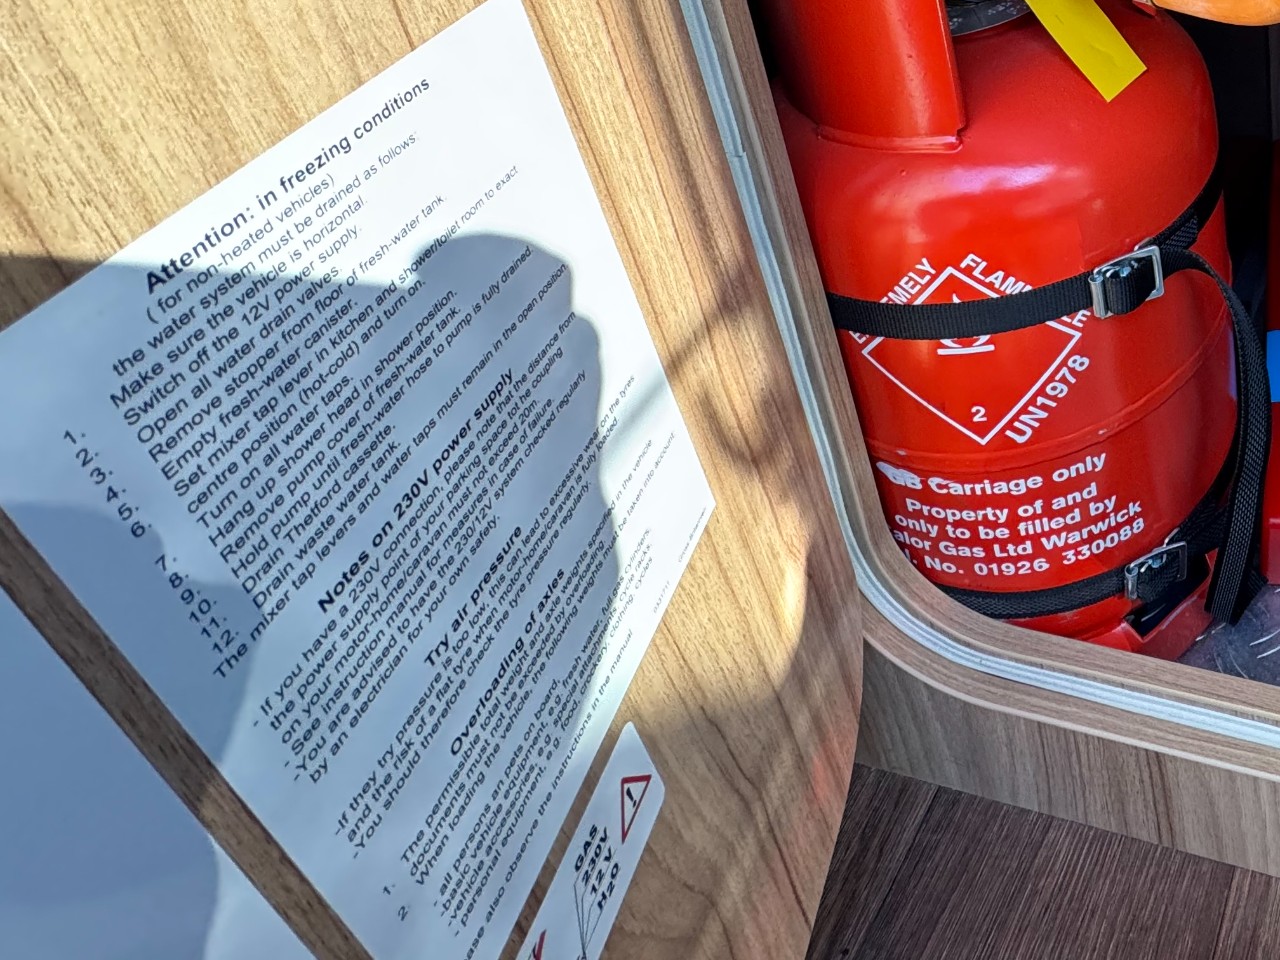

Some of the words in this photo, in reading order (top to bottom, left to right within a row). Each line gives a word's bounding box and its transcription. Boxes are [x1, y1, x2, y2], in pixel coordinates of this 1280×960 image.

[111, 347, 146, 377] the
[145, 304, 197, 350] water
[198, 260, 257, 310] system
[256, 227, 295, 265] must
[292, 214, 313, 235] be
[313, 173, 362, 218] drained
[361, 163, 378, 181] as
[145, 205, 255, 296] Attention:
[254, 189, 279, 211] in
[278, 135, 352, 194] freezing
[352, 77, 430, 140] conditions
[61, 428, 87, 446] 1.
[108, 361, 165, 411] Make
[165, 327, 206, 364] sure
[205, 303, 235, 331] the
[234, 260, 288, 306] vehicle
[286, 247, 303, 264] is
[74, 445, 100, 469] 2.
[121, 370, 187, 427] Switch
[187, 344, 211, 374] off
[210, 325, 240, 353] the
[239, 292, 270, 327] 12V
[272, 259, 316, 305] power
[88, 465, 115, 487] 3.
[135, 396, 190, 445] Open
[189, 372, 213, 400] all
[210, 335, 256, 380] water
[257, 303, 297, 341] drain
[294, 265, 343, 306] valves.
[848, 257, 937, 344] EMELY
[1004, 354, 1090, 444] UN1978
[116, 501, 141, 522] 5.
[158, 424, 218, 482] Empty
[217, 345, 302, 429] fresh-water
[302, 297, 359, 350] canister.
[152, 552, 178, 573] 7.
[194, 488, 239, 529] Turn
[238, 465, 262, 491] on
[261, 441, 282, 468] all
[279, 402, 320, 447] water
[319, 374, 355, 408] taps.
[167, 571, 190, 591] 8.
[206, 498, 256, 549] Hang
[253, 475, 277, 501] up
[276, 420, 326, 478] shower
[325, 383, 362, 425] head
[358, 373, 375, 391] in
[373, 329, 414, 380] shower
[413, 289, 458, 337] position.
[178, 586, 203, 606] 9.
[218, 493, 285, 565] Remove
[284, 449, 326, 498] pump
[325, 408, 361, 451] cover
[361, 390, 376, 413] of
[374, 328, 437, 399] fresh-water
[434, 305, 462, 334] tank.
[316, 549, 370, 615] Notes
[370, 519, 394, 549] on
[392, 467, 429, 522] 230V
[431, 416, 472, 477] power
[472, 366, 513, 421] supply
[905, 497, 1009, 524] Property
[1017, 499, 1044, 518] of
[1051, 482, 1098, 510] and
[927, 476, 1043, 496] Carriage
[1052, 453, 1106, 483] only
[970, 405, 987, 422] 2
[199, 614, 228, 639] 11.
[240, 545, 285, 595] Drain
[281, 477, 344, 545] Thetford
[341, 423, 397, 483] cassette.
[210, 627, 240, 656] 12.
[250, 560, 296, 612] Drain
[292, 513, 336, 561] waste
[334, 468, 371, 514] water
[369, 439, 402, 473] tank.
[422, 630, 450, 668] Try
[450, 601, 469, 633] air
[468, 525, 522, 608] pressure
[887, 529, 932, 552] alor
[938, 541, 986, 559] Gas
[993, 540, 1034, 558] Ltd
[1040, 500, 1143, 551] Warwick
[894, 514, 938, 538] only
[945, 524, 971, 539] to
[978, 525, 1010, 541] be
[1017, 508, 1081, 537] filled
[1089, 495, 1117, 517] by
[923, 555, 965, 575] No.
[973, 558, 1051, 576] 01926
[1062, 517, 1145, 566] 330088
[307, 754, 329, 785] by
[328, 729, 350, 757] an
[345, 643, 409, 729] electrician
[406, 618, 424, 645] for
[422, 583, 448, 624] your
[447, 551, 471, 587] own
[468, 513, 501, 556] safety.
[381, 747, 422, 811] should
[418, 678, 467, 750] therefore
[463, 631, 496, 678] check
[492, 607, 510, 633] the
[507, 582, 527, 610] tyre
[524, 528, 560, 586] pressure
[557, 479, 592, 531] regularly.
[408, 781, 466, 877] documents
[464, 737, 492, 781] must
[488, 710, 507, 739] not
[502, 686, 518, 713] be
[517, 621, 556, 690] exceeded
[552, 604, 566, 625] by
[564, 538, 607, 607] overloading.
[449, 635, 525, 757] Overloading
[523, 609, 537, 635] of
[536, 567, 565, 614] axles
[575, 824, 598, 872] GAS
[582, 826, 608, 887] 230V
